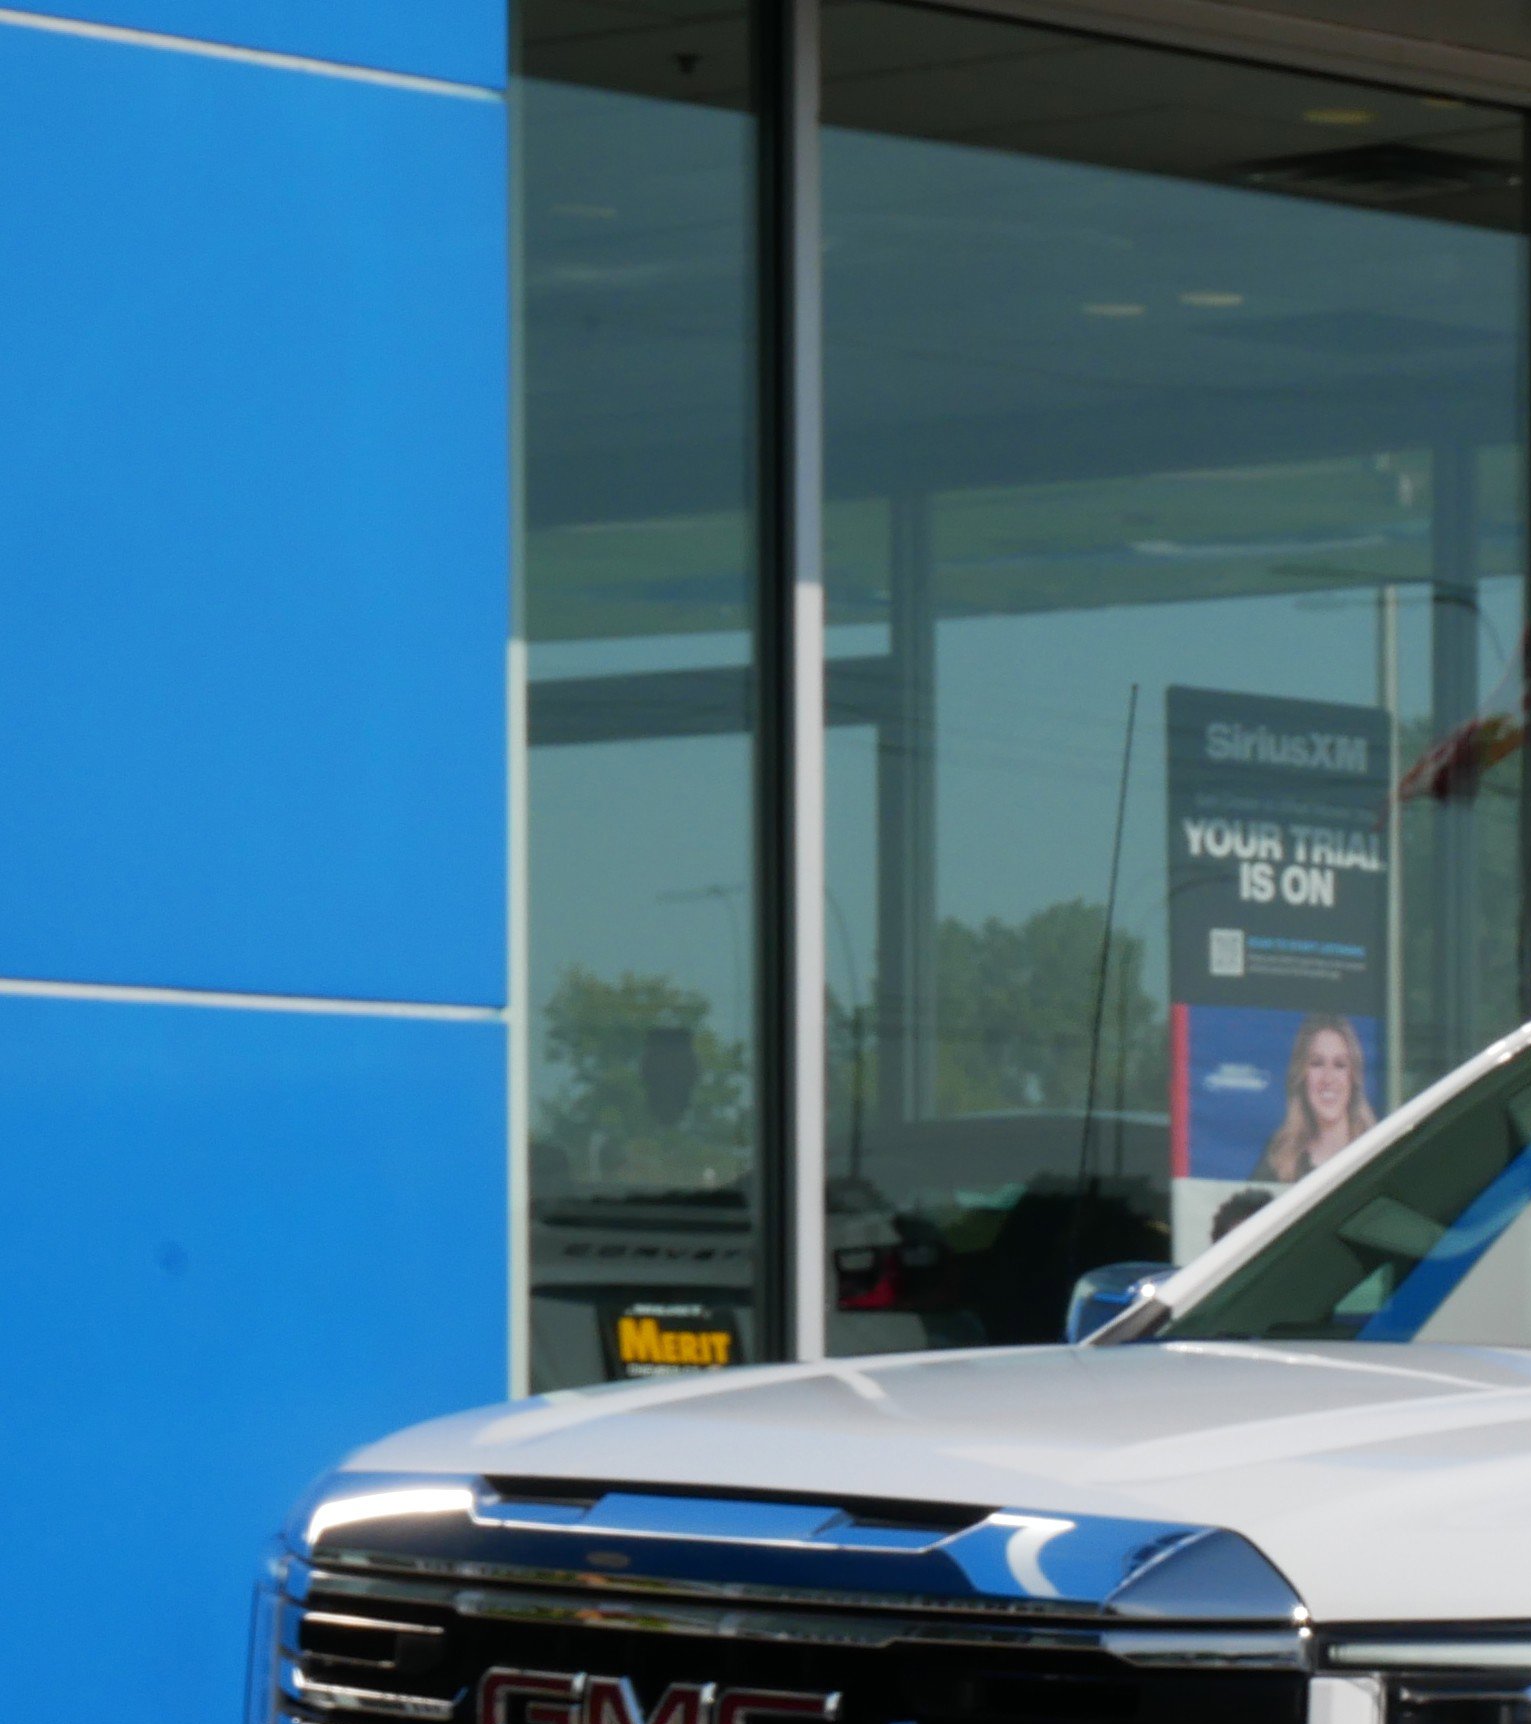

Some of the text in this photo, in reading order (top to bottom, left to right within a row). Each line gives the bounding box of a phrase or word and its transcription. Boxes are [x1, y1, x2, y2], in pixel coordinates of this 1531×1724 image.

[1206, 722, 1367, 773] SiriusXM
[1183, 818, 1386, 871] YOUR TRIAL
[1238, 862, 1336, 908] IS ON
[618, 1316, 731, 1364] MERIT
